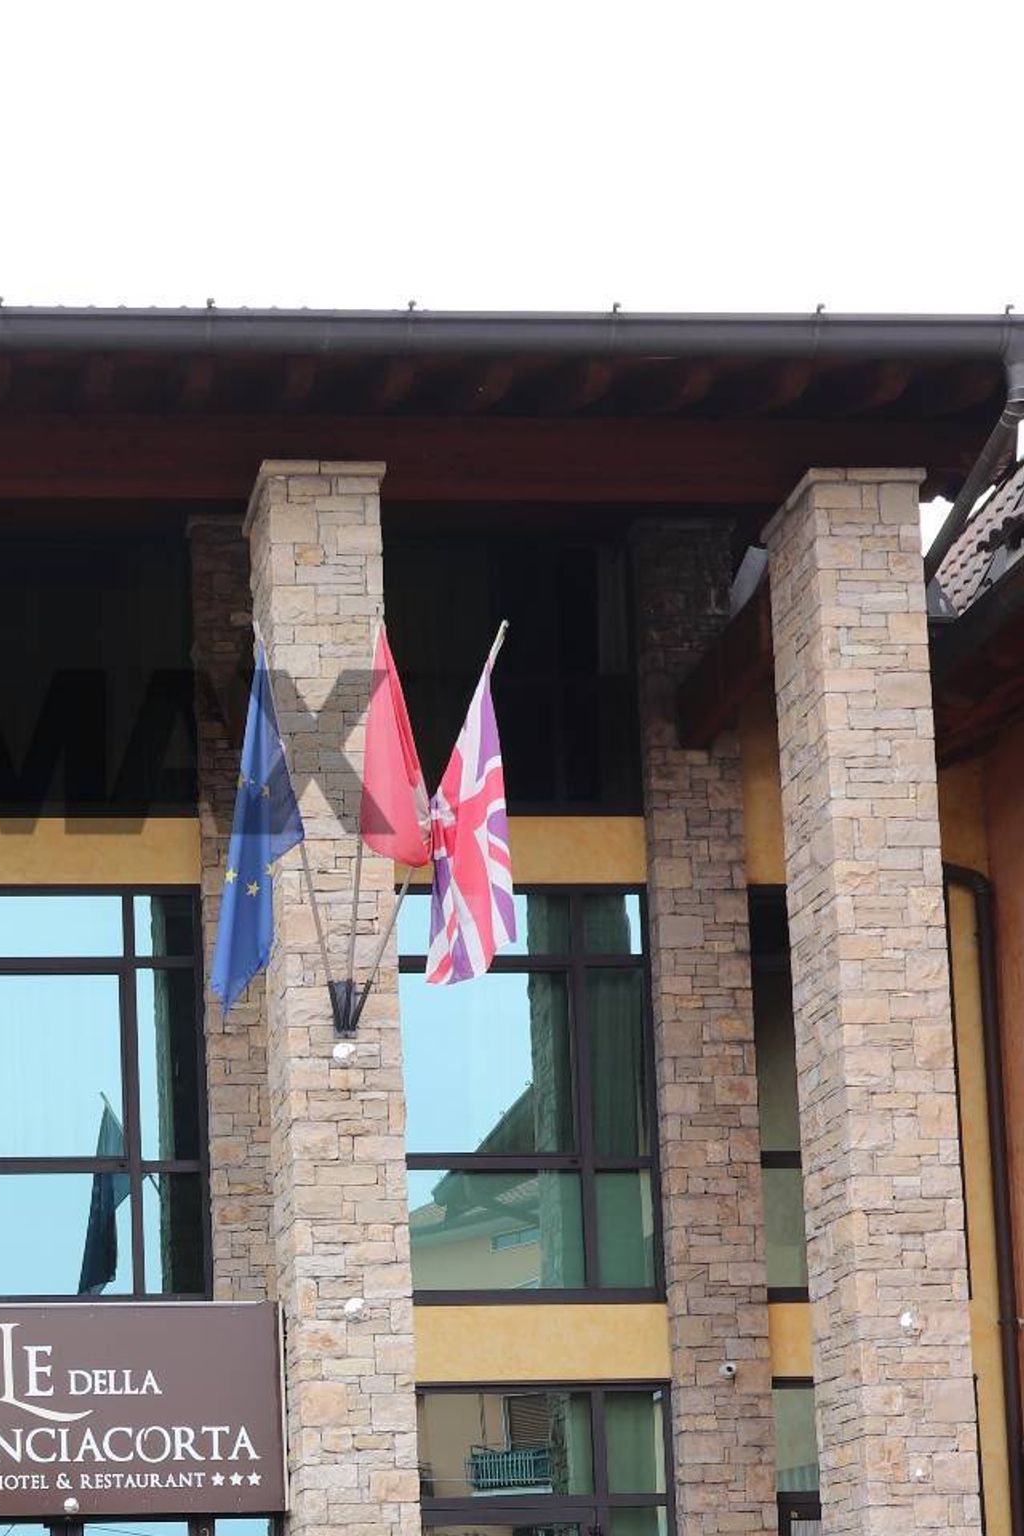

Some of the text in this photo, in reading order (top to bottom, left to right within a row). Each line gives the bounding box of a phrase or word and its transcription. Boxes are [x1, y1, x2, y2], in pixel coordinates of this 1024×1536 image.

[69, 1369, 163, 1395] DELLA
[56, 1473, 73, 1490] &
[80, 1472, 206, 1489] RESTAURANT
